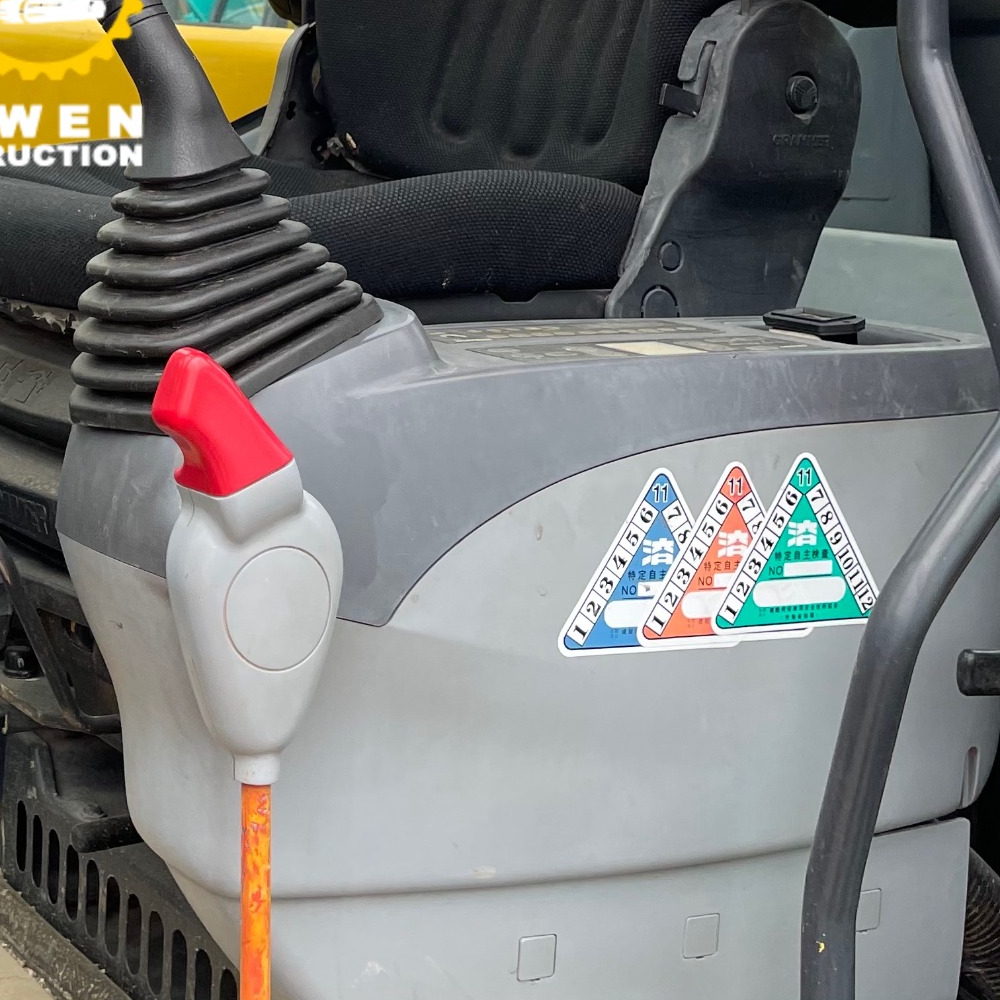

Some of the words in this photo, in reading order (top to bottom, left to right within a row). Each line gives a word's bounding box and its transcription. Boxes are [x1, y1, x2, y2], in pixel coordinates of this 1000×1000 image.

[728, 478, 743, 495] 11
[798, 468, 812, 486] 11
[652, 483, 668, 502] 11
[742, 498, 755, 510] 7
[668, 506, 681, 519] 7
[678, 530, 691, 544] 8
[787, 520, 817, 547] 済
[642, 538, 674, 566] 済
[717, 530, 748, 558] 済
[724, 604, 738, 617] 1
[737, 582, 750, 597] 2
[749, 558, 761, 574] 3
[761, 536, 774, 551] 4
[774, 513, 785, 528] 5
[786, 490, 798, 506] 6
[775, 549, 829, 561] 特定自主検査
[811, 491, 824, 502] 7
[821, 511, 833, 525] 8
[830, 532, 842, 545] 9
[838, 550, 852, 570] 10
[848, 570, 863, 590] 11
[859, 590, 874, 610] 12
[573, 626, 587, 640] 1
[587, 600, 601, 617] 2
[600, 577, 614, 594] 3
[613, 554, 627, 570] 4
[626, 530, 640, 547] 5
[640, 508, 653, 523] 6
[652, 616, 665, 630] 1
[665, 591, 678, 607] 2
[677, 568, 690, 584] 3
[690, 546, 702, 561] 4
[702, 522, 714, 538] 5
[716, 500, 728, 515] 6
[769, 567, 782, 576] NO
[622, 585, 636, 595] NO
[698, 576, 713, 586] NO
